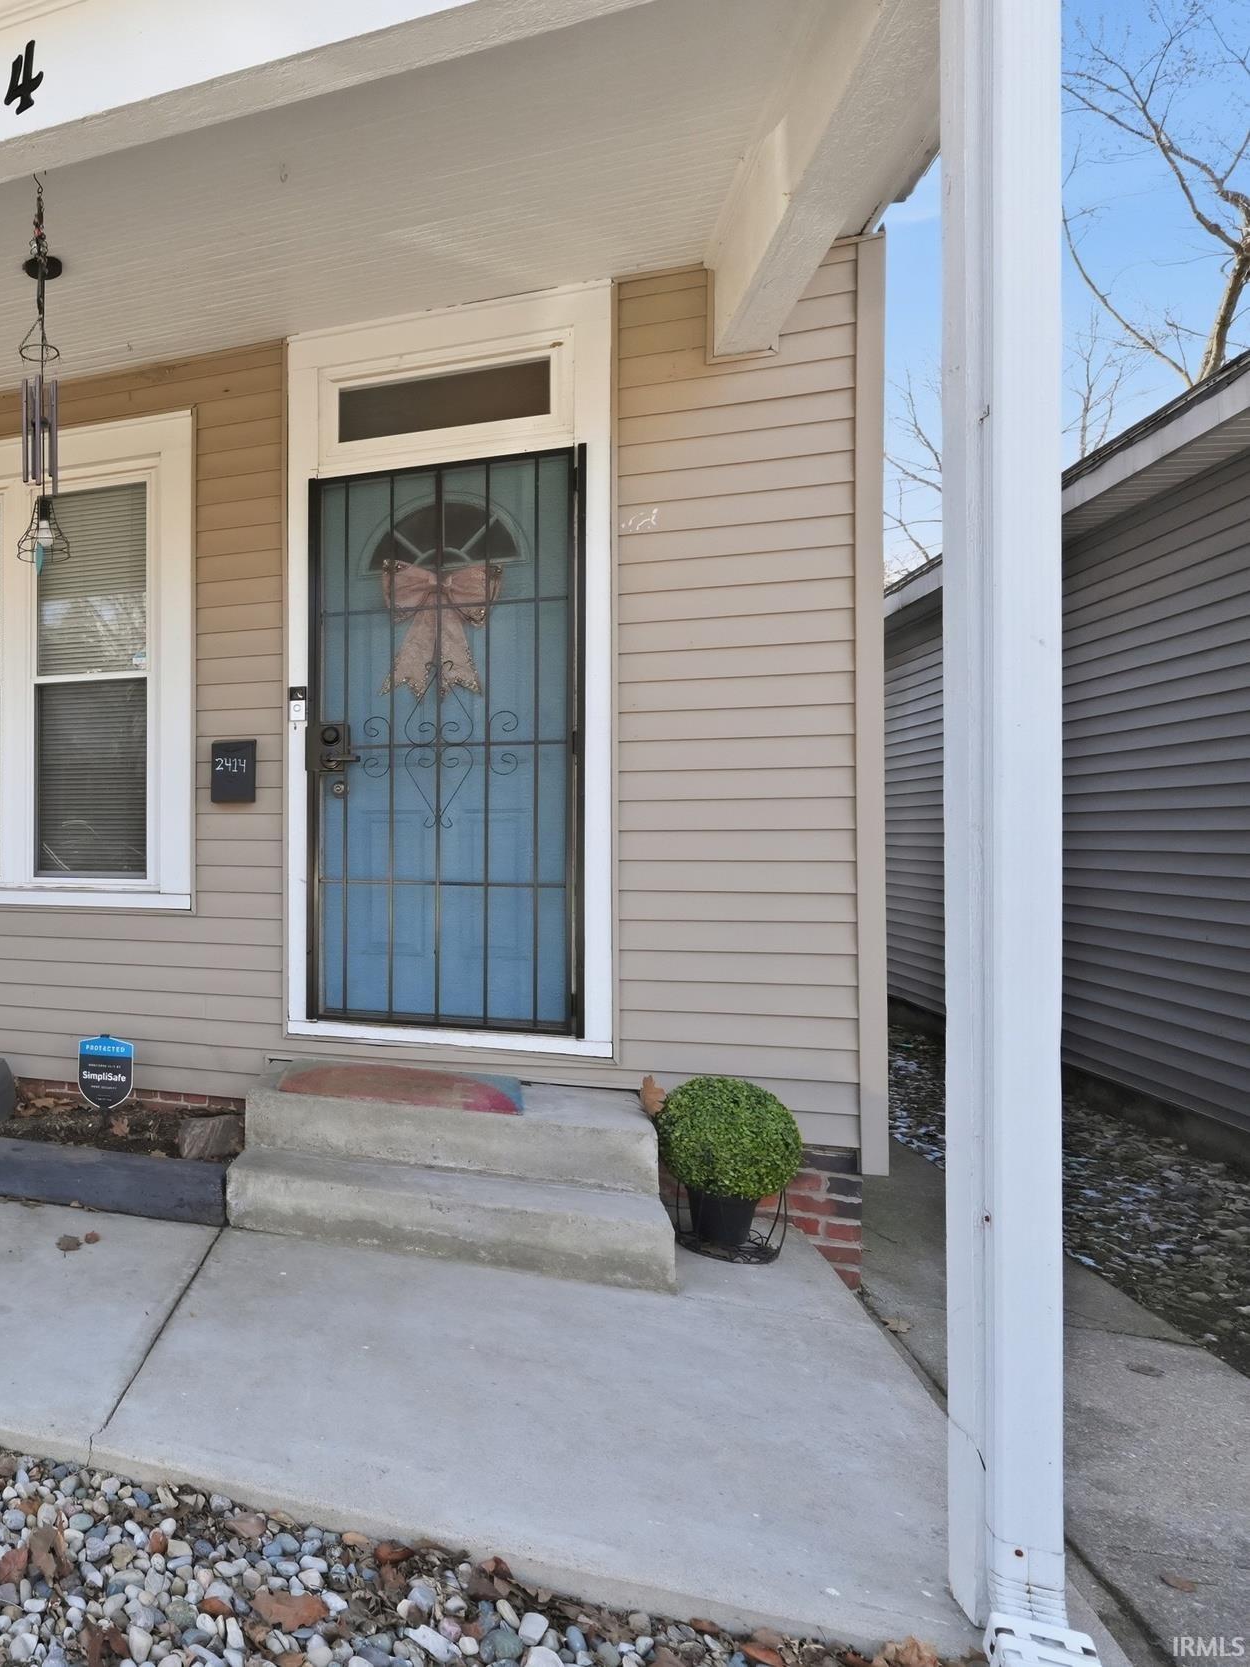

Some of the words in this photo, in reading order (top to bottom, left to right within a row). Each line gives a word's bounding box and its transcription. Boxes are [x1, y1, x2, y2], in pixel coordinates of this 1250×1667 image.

[215, 757, 246, 773] 2414
[85, 1044, 126, 1053] PROTECTED
[82, 1070, 126, 1082] SimpliSafe
